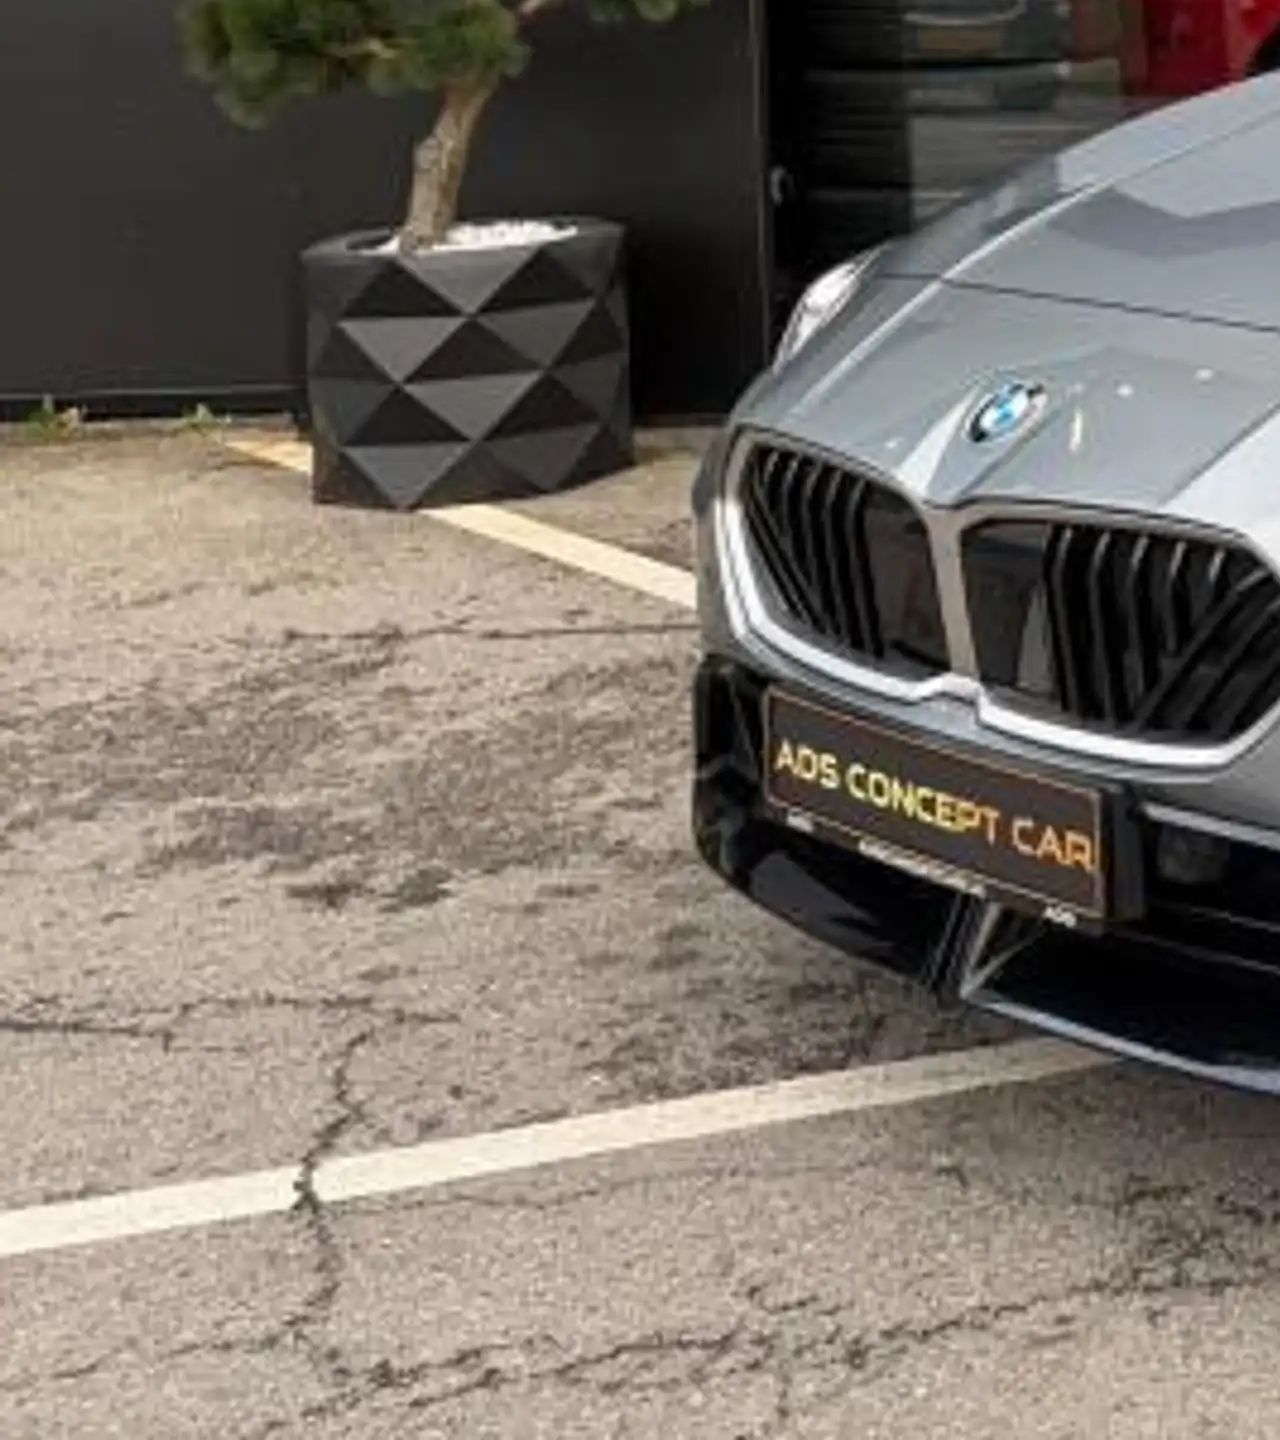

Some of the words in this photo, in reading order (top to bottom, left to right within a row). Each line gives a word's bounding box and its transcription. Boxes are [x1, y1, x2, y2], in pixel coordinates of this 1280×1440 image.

[774, 737, 841, 790] ADS
[845, 762, 1000, 848] CONCEPT
[1011, 816, 1095, 875] CAR
